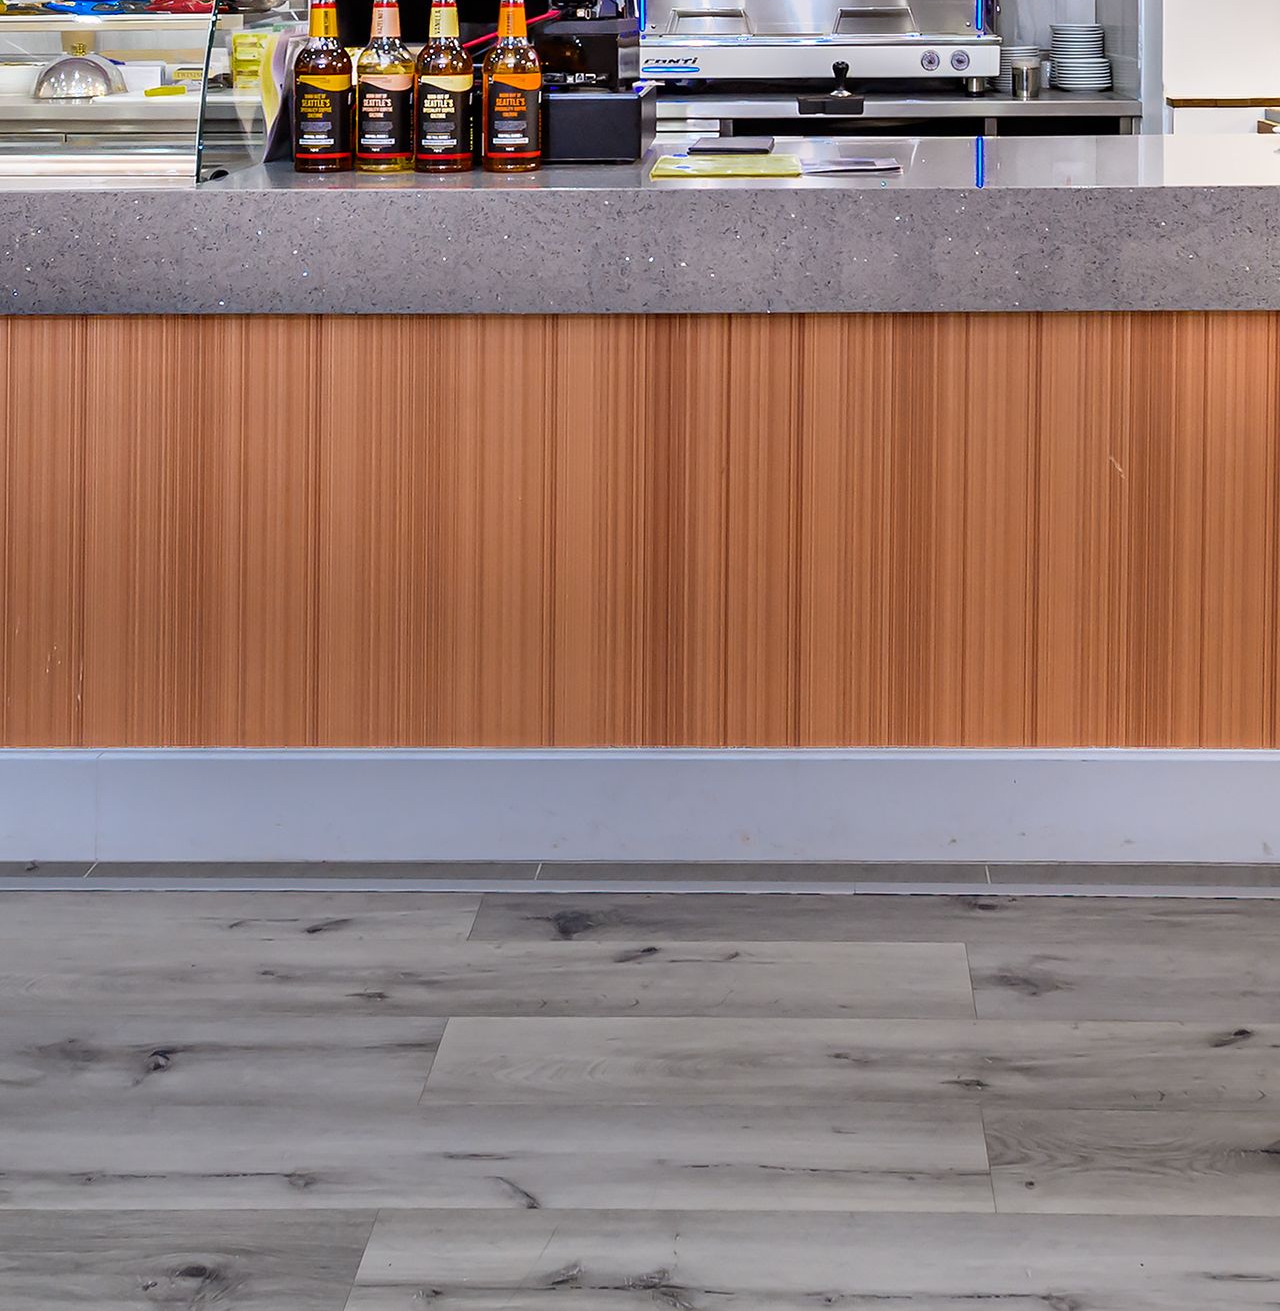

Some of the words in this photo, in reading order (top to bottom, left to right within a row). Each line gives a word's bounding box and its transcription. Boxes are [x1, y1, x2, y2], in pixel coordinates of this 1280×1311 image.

[434, 9, 442, 35] VANILLA
[301, 99, 331, 107] SEATTLE'S
[363, 99, 392, 107] SEATTLE'S
[424, 99, 454, 107] SEATTLE'S
[496, 98, 526, 106] SEATTLE'S
